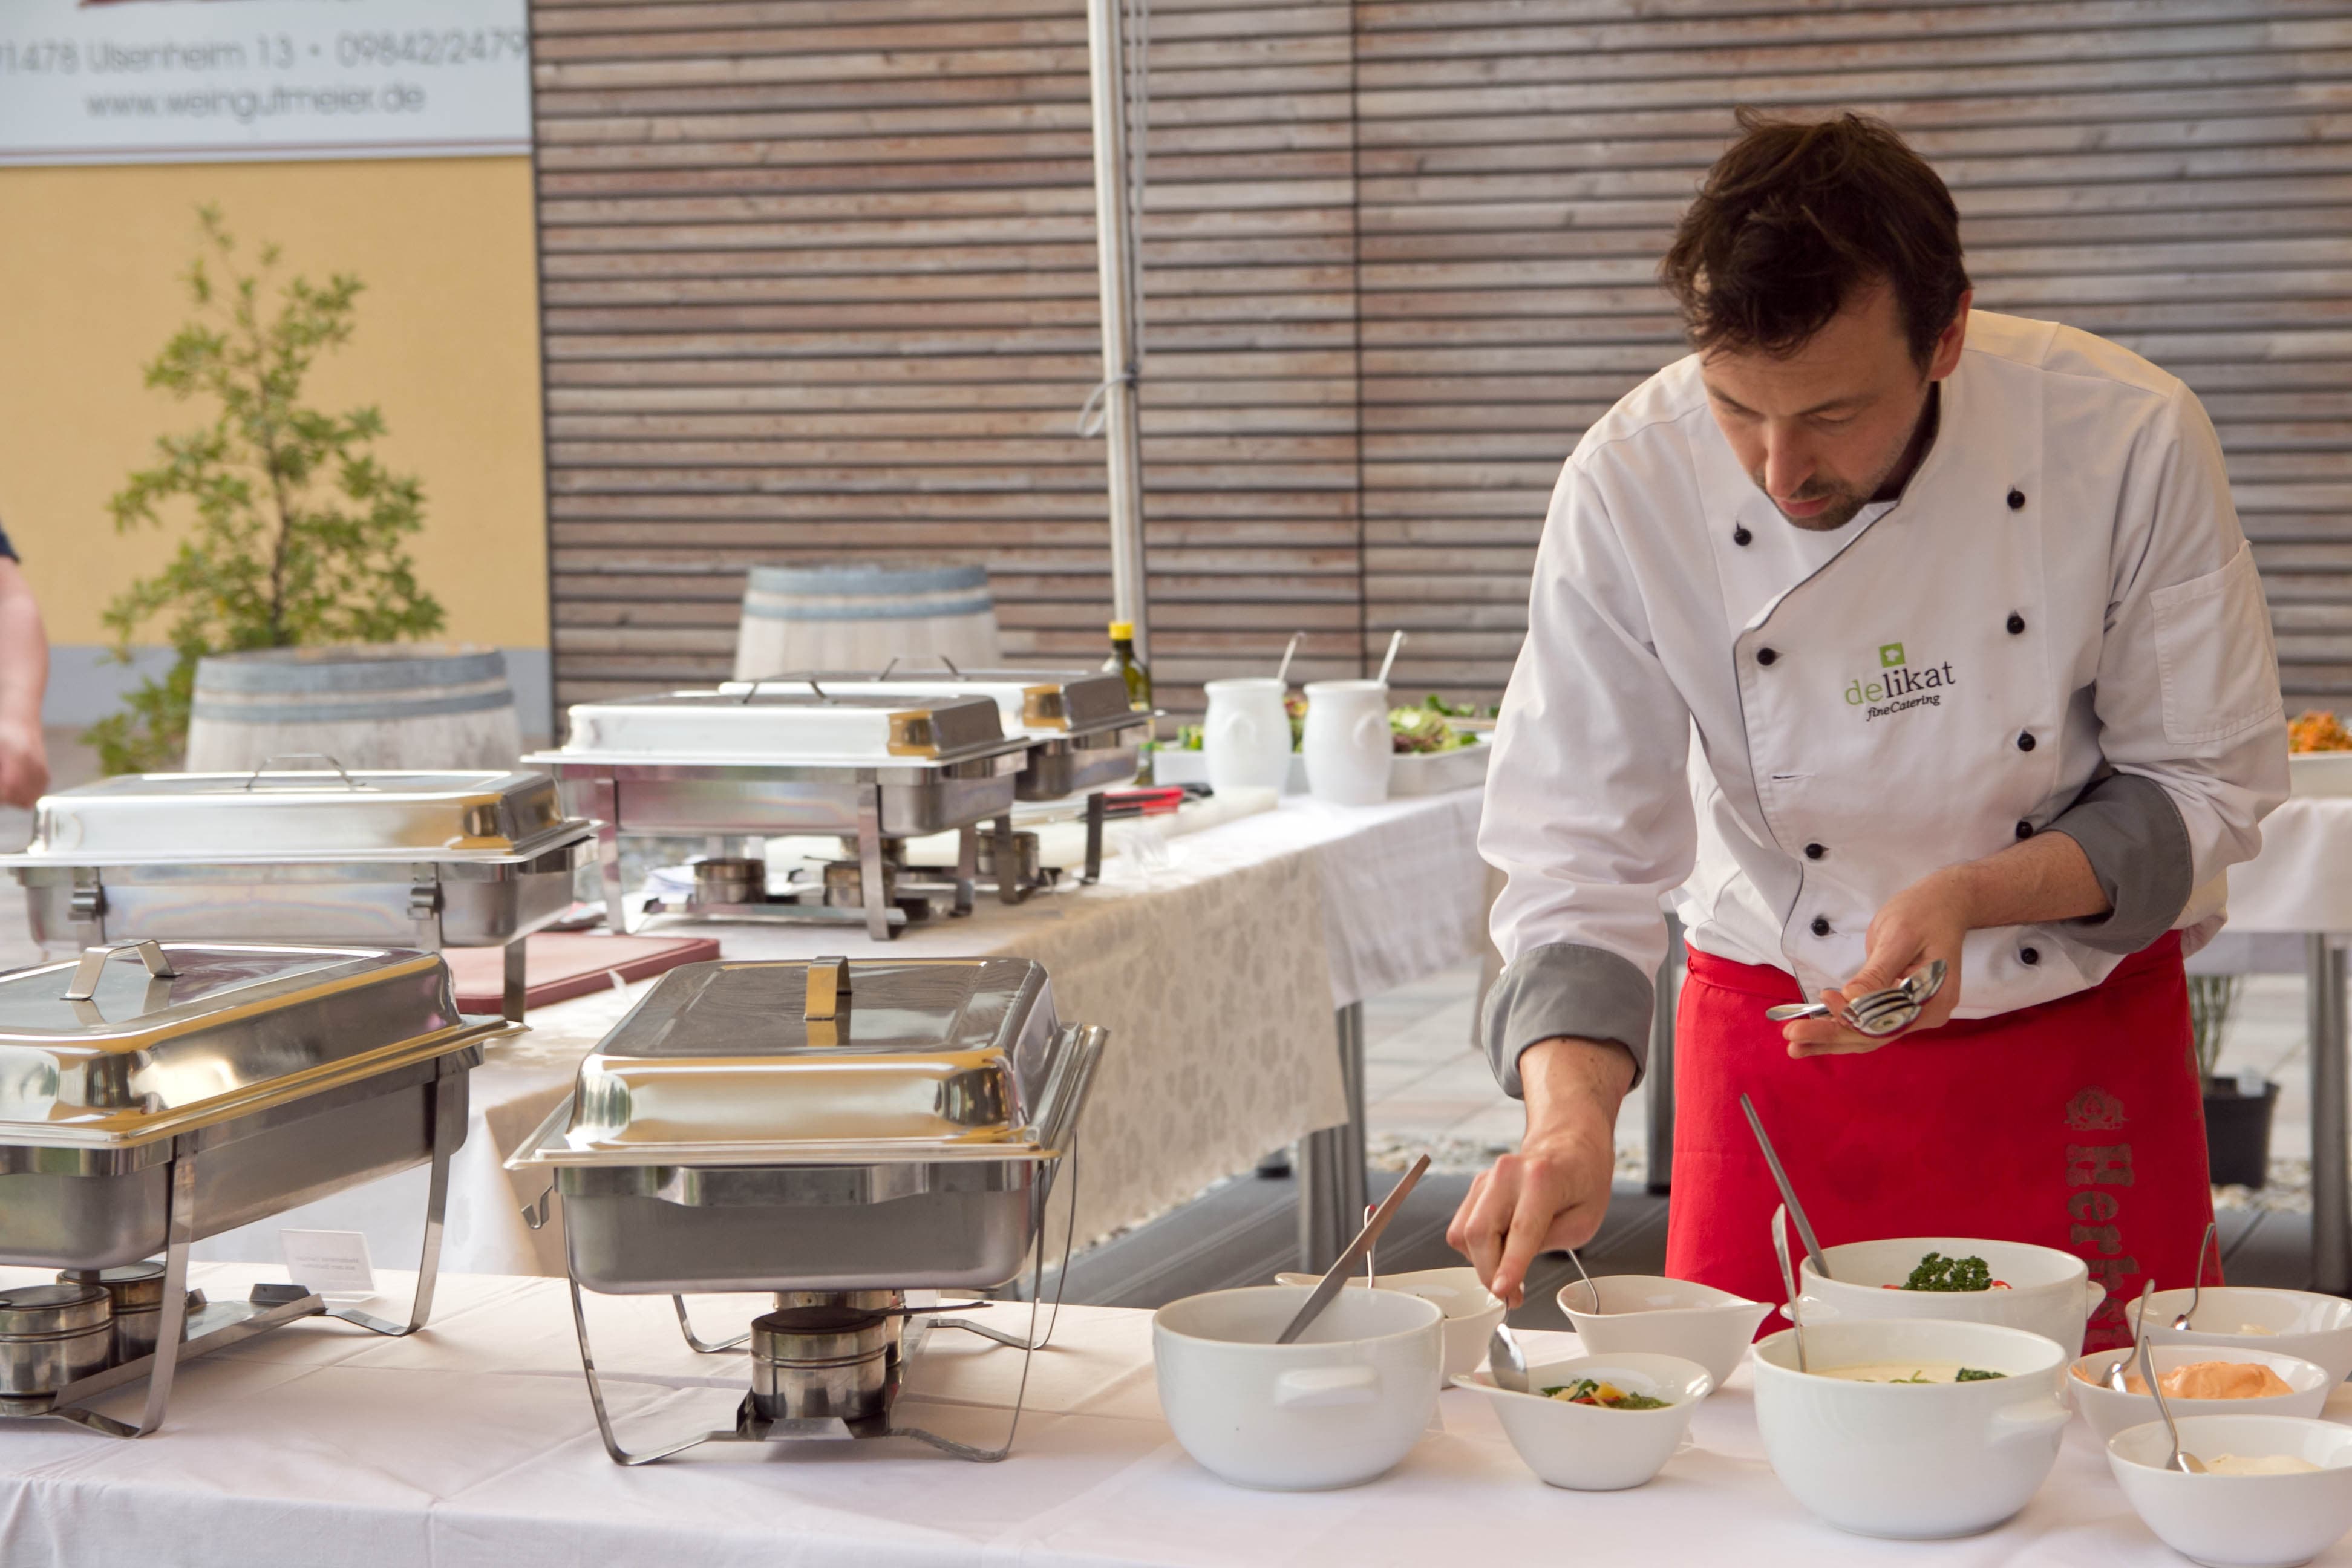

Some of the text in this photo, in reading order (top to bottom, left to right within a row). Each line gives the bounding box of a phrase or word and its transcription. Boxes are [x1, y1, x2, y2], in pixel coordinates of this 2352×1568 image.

[258, 32, 295, 68] 13
[85, 80, 426, 123] www.weingutmeier.de
[1845, 661, 1956, 705] delikat
[1866, 695, 1941, 721] fineCatering
